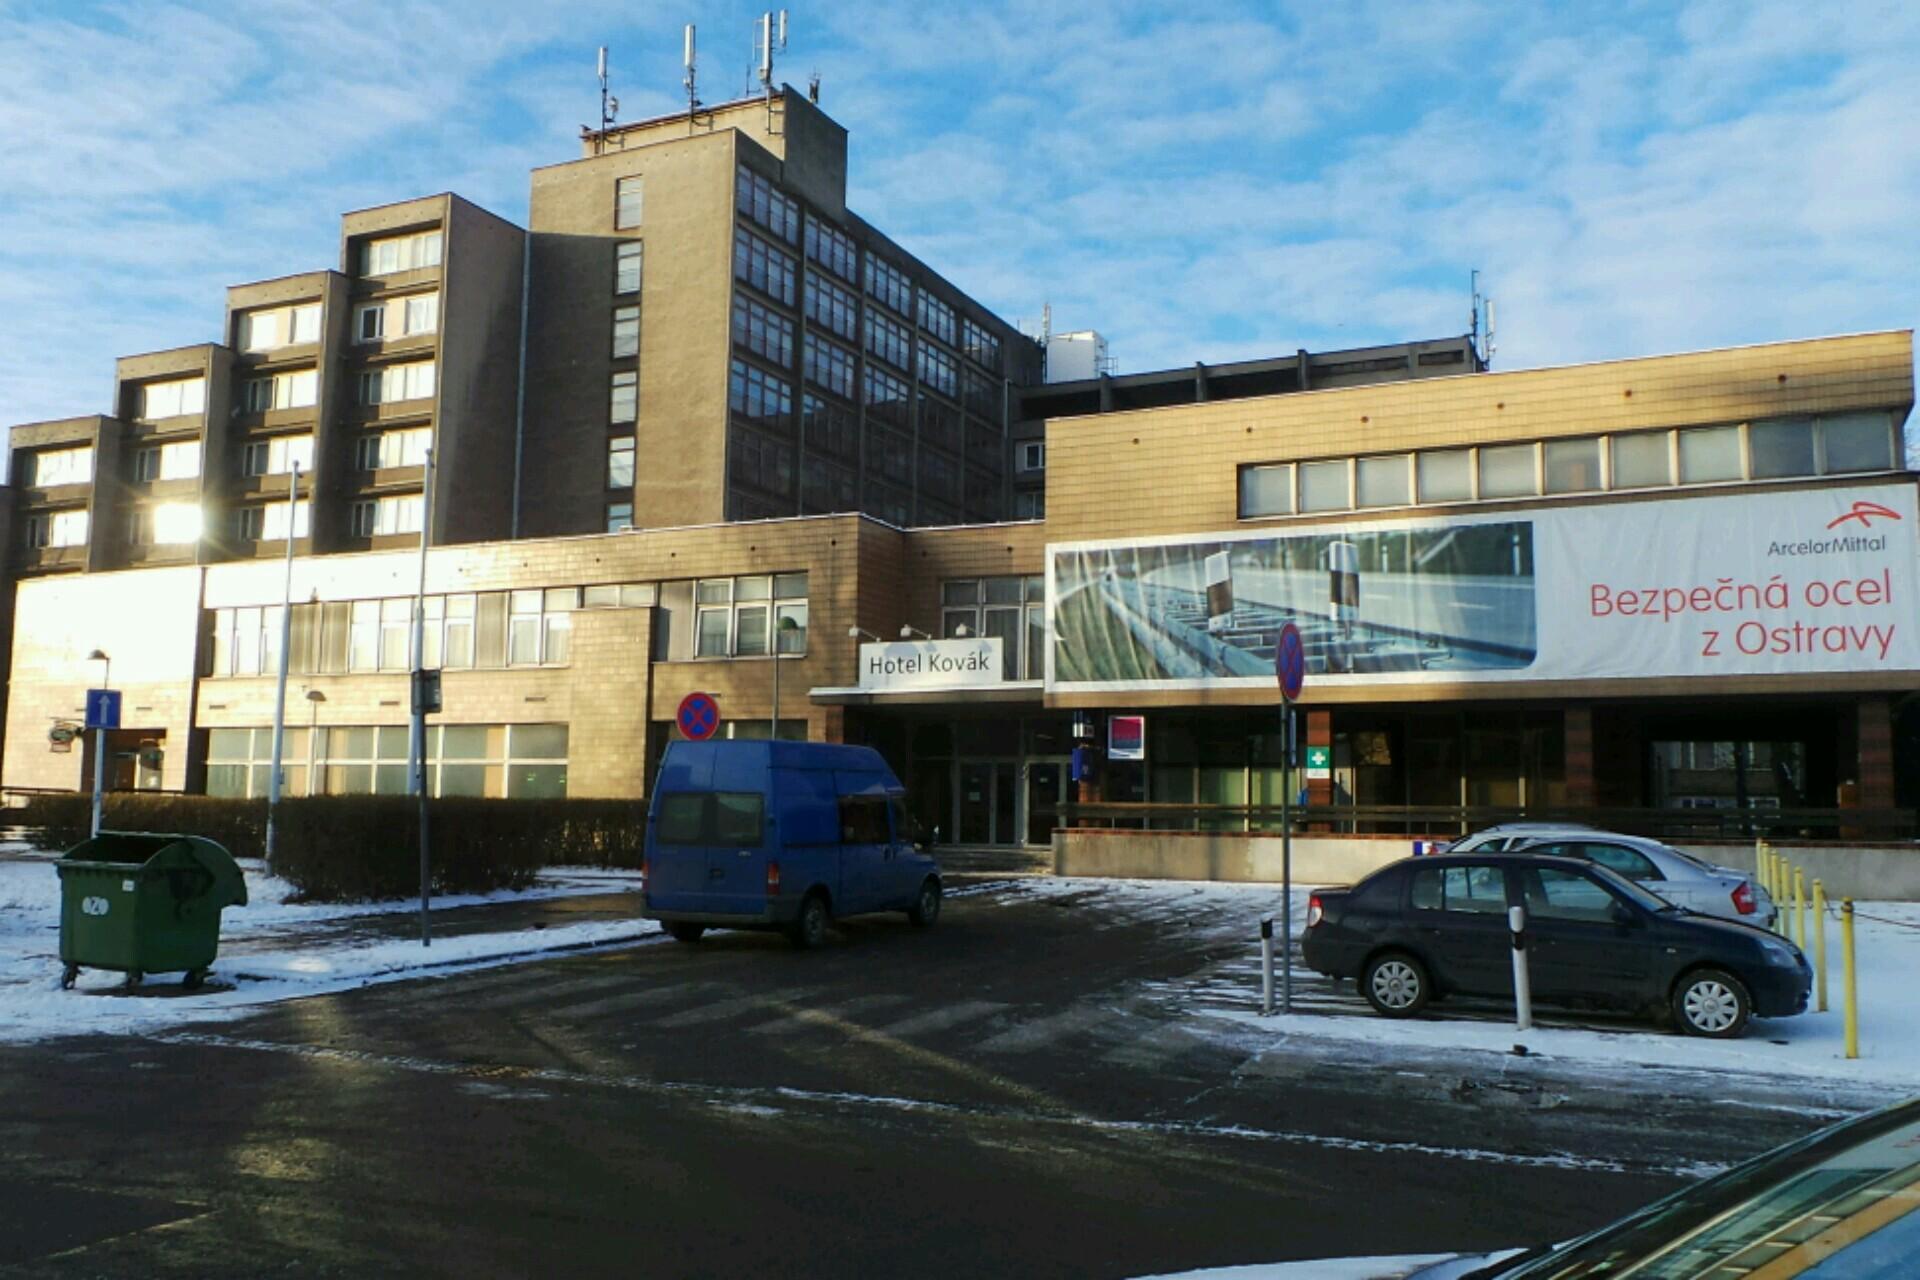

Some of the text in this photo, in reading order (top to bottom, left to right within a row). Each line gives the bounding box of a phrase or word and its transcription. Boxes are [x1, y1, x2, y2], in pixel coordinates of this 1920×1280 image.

[1768, 535, 1886, 556] ArcelorMittal
[1591, 568, 1891, 622] Bezpečná ocel
[1702, 621, 1895, 660] z Ostravy
[870, 651, 989, 674] Hotel Kovák
